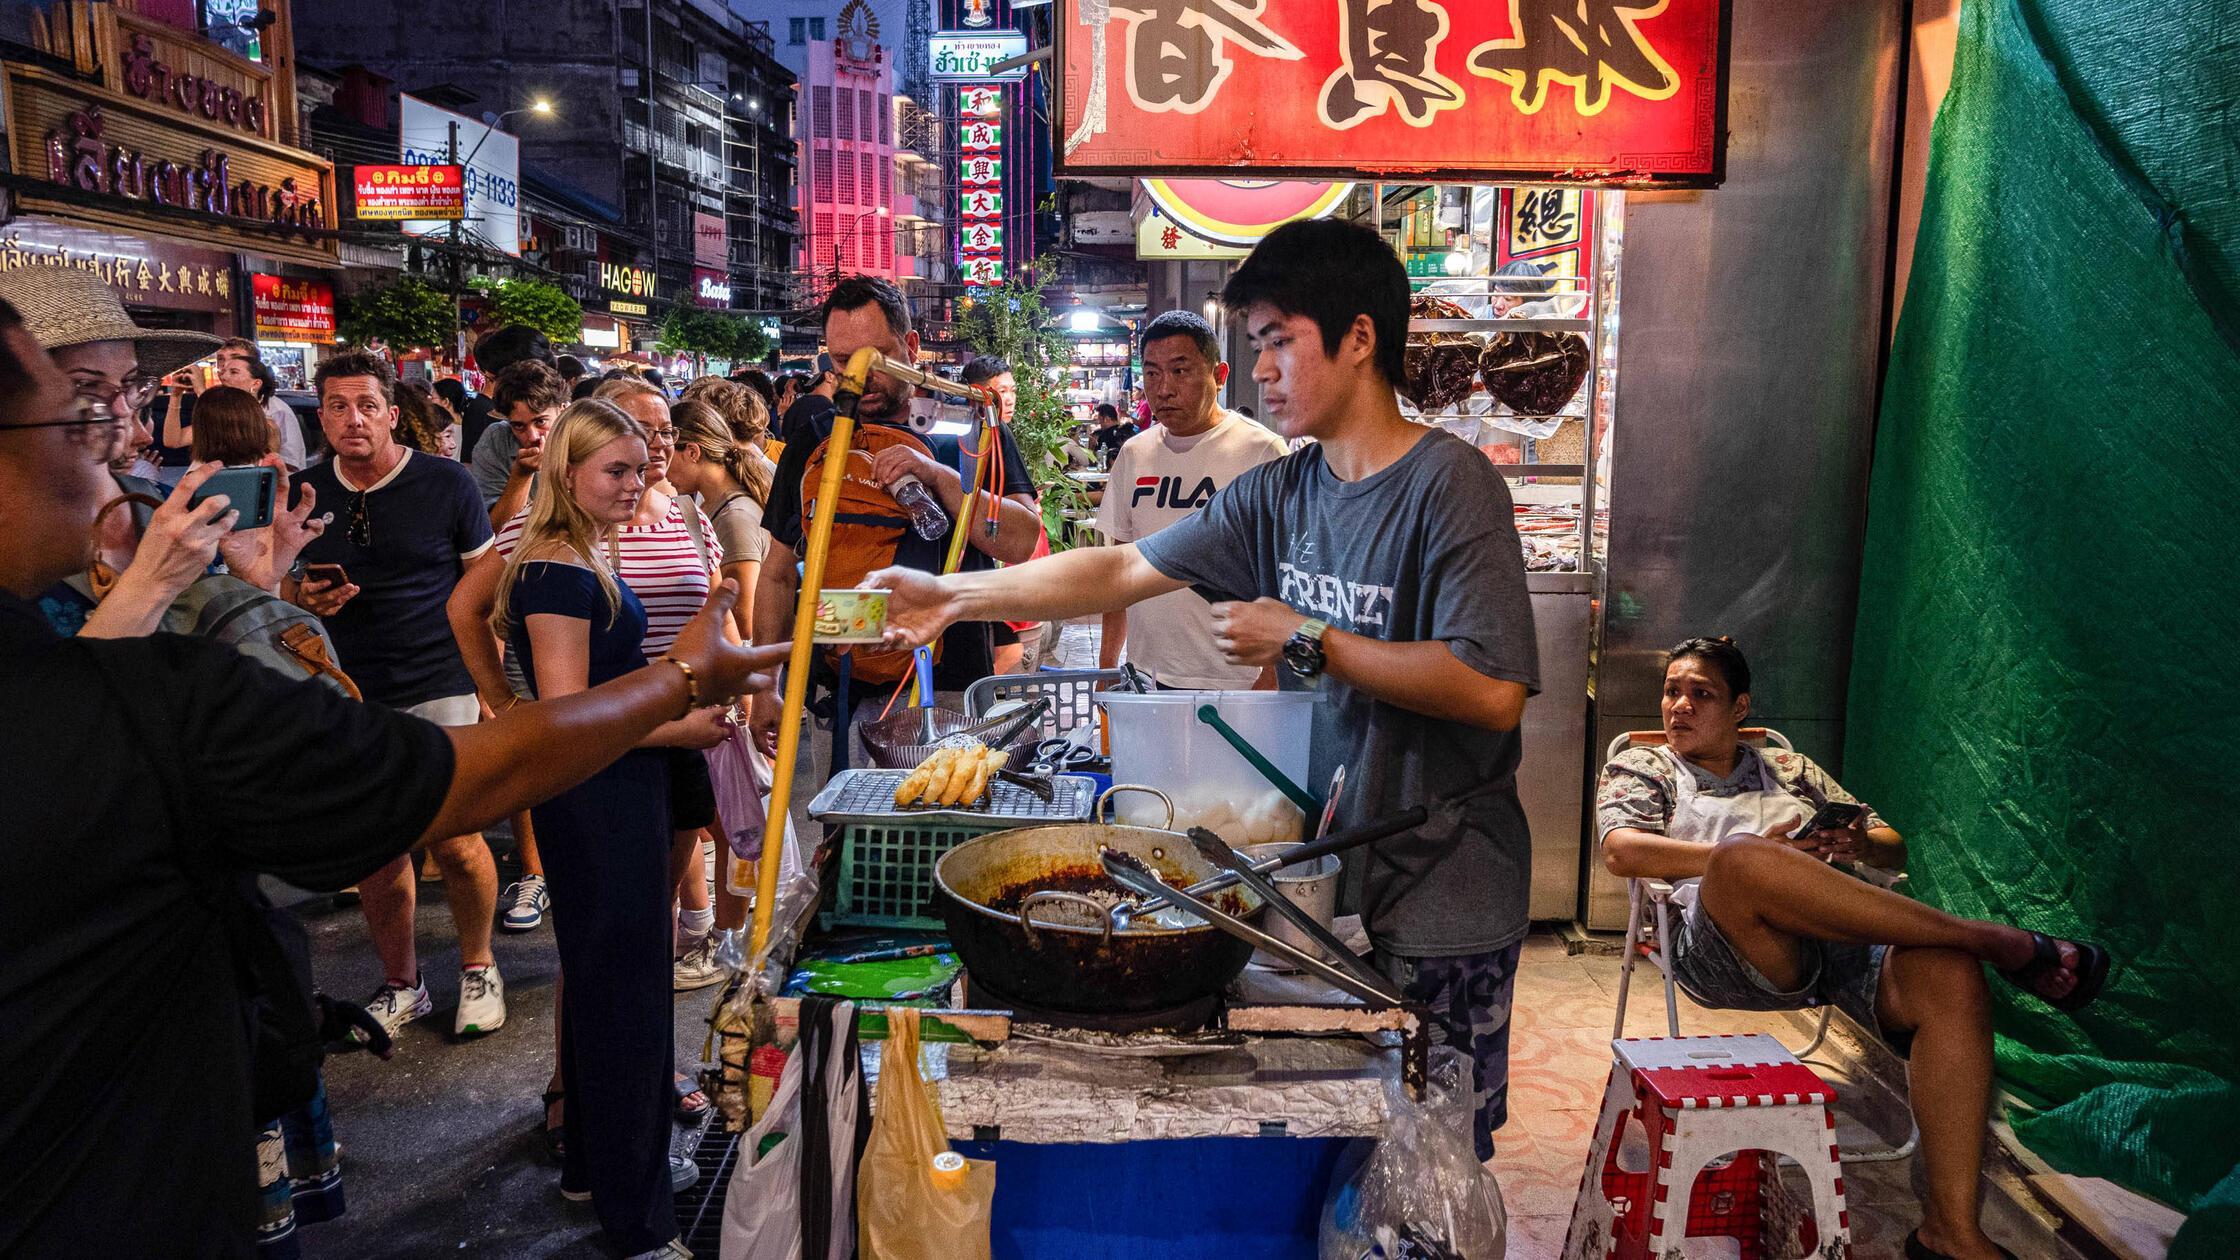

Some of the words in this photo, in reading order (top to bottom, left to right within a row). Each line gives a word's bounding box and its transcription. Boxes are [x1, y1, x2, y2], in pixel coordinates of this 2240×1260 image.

[600, 262, 656, 298] HAGOW
[700, 277, 731, 301] Bata
[858, 477, 880, 489] VAU
[1131, 476, 1217, 508] FILA
